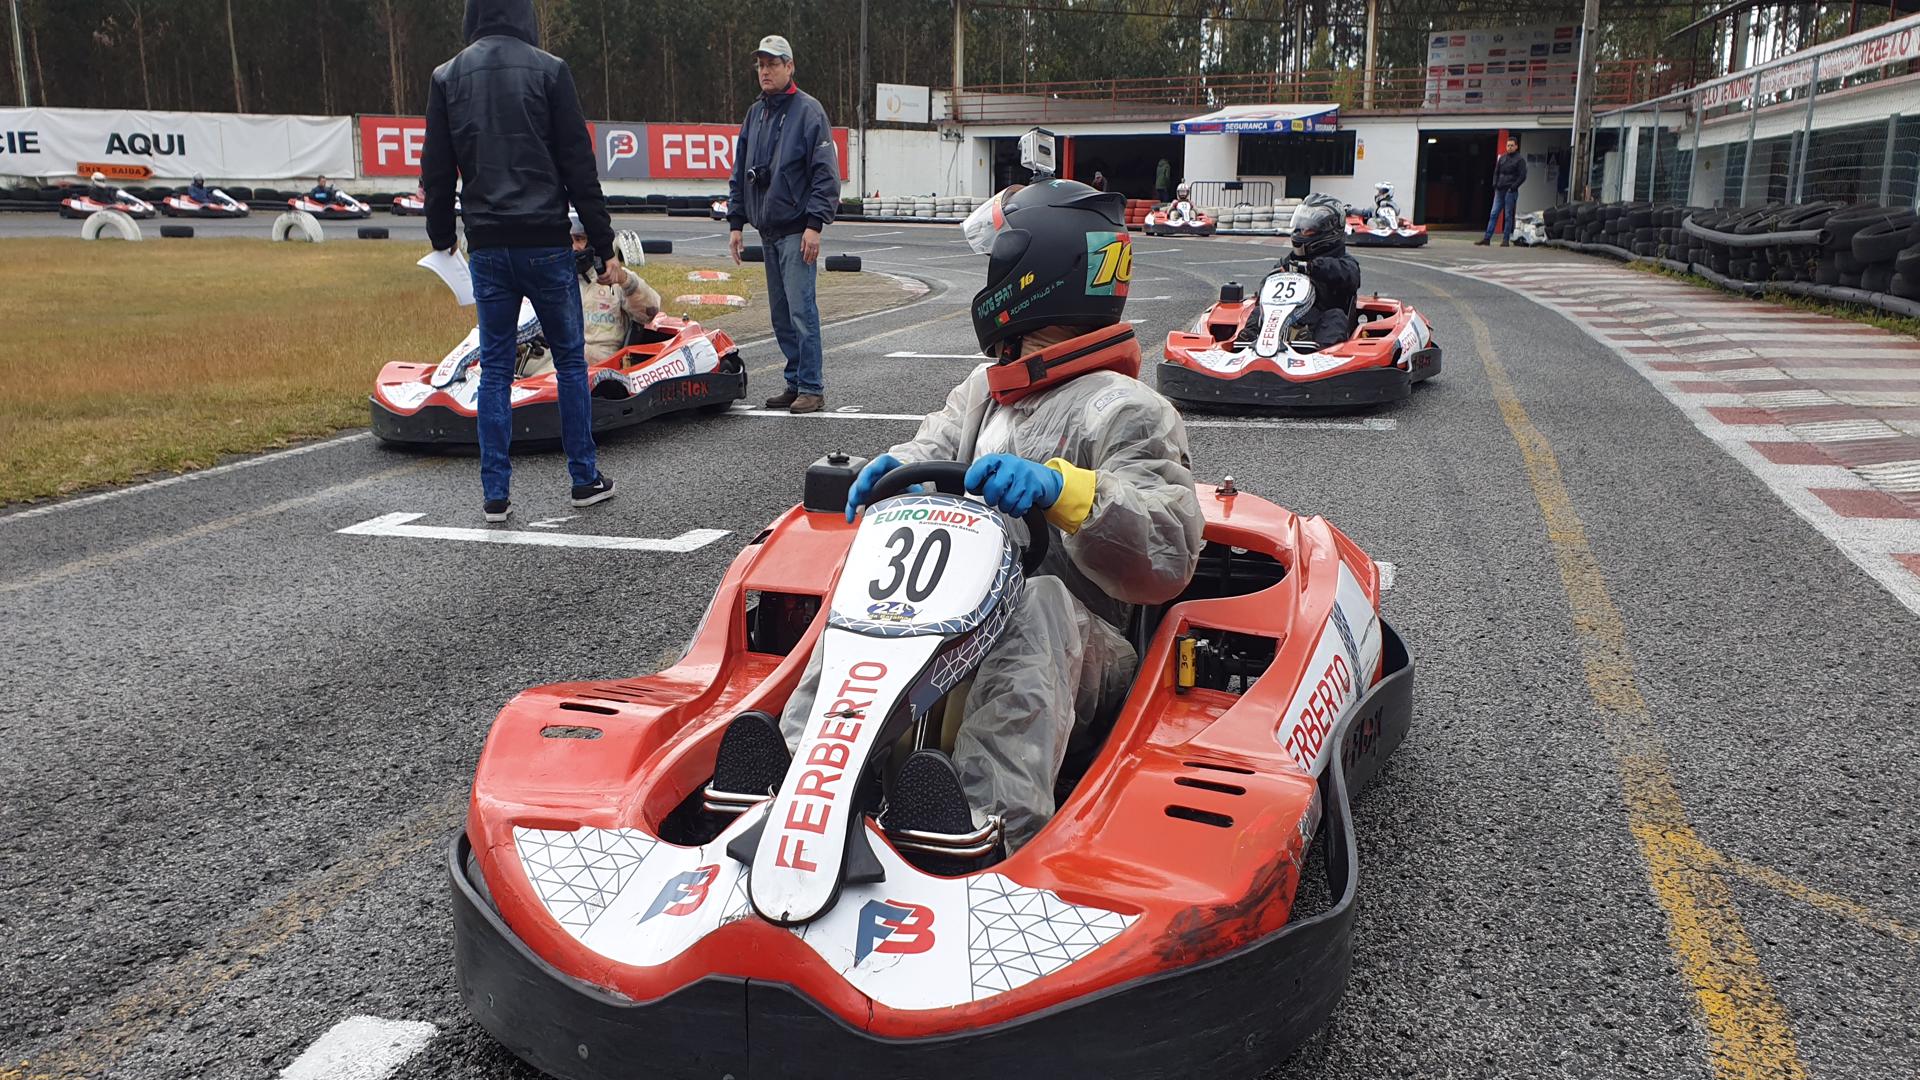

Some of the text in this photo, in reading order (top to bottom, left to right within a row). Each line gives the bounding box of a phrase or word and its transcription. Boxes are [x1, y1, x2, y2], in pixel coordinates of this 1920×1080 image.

[1225, 122, 1267, 131] SEGURANÇA
[105, 133, 186, 156] AQUI
[662, 133, 739, 169] FER
[1090, 240, 1132, 288] 16
[1020, 271, 1035, 290] 16
[1272, 282, 1297, 299] 25
[632, 358, 685, 392] FERBERTO
[873, 509, 981, 528] EUROINDY
[868, 526, 952, 603] 30
[775, 661, 888, 873] FERBERTO
